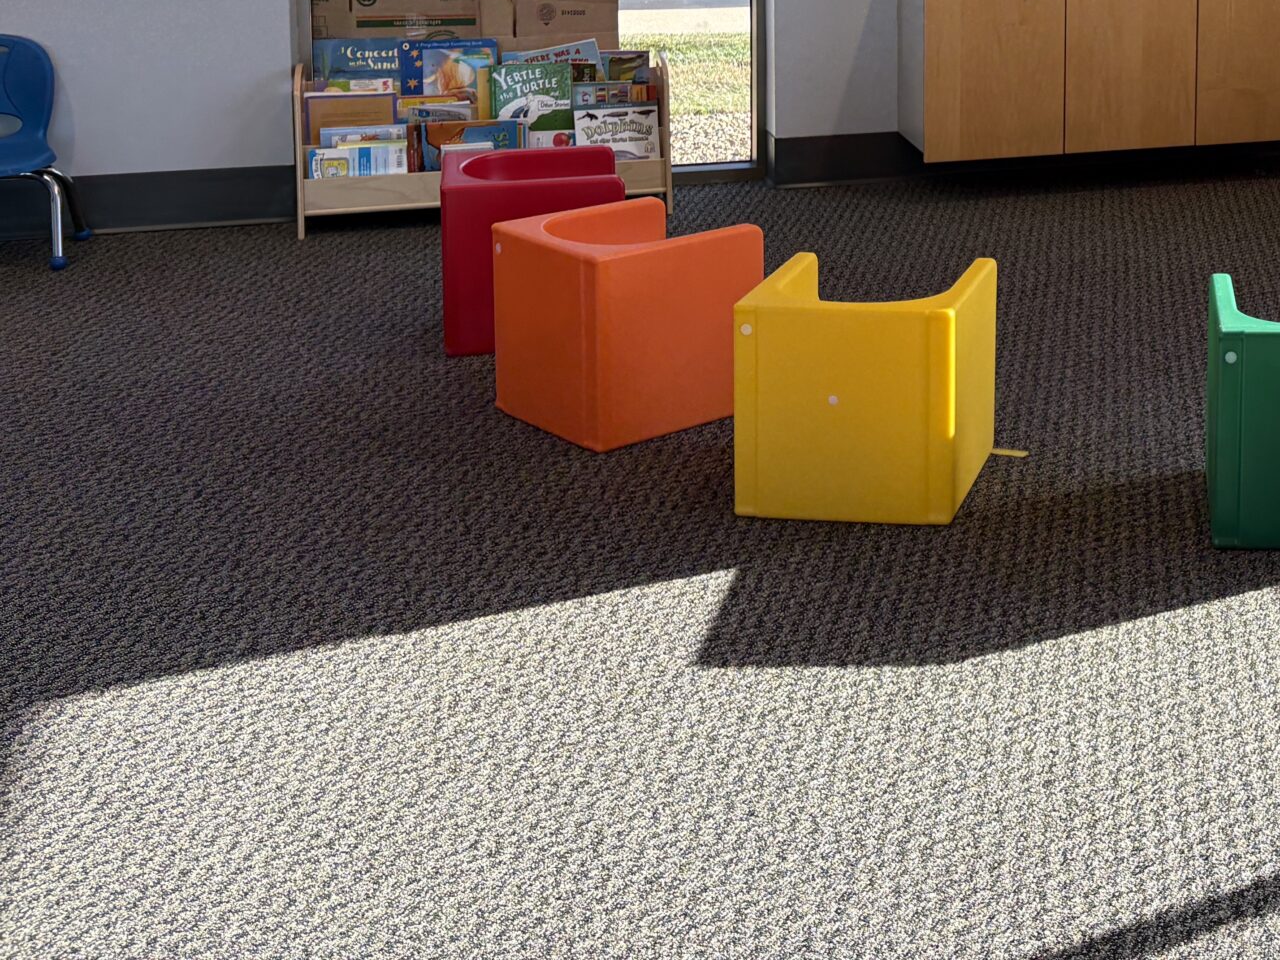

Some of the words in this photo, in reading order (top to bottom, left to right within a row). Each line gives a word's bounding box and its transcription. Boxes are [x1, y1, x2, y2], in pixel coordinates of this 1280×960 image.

[368, 58, 399, 70] Sand
[492, 68, 541, 90] YERTLE
[500, 92, 513, 101] the
[512, 78, 558, 96] TURTLE
